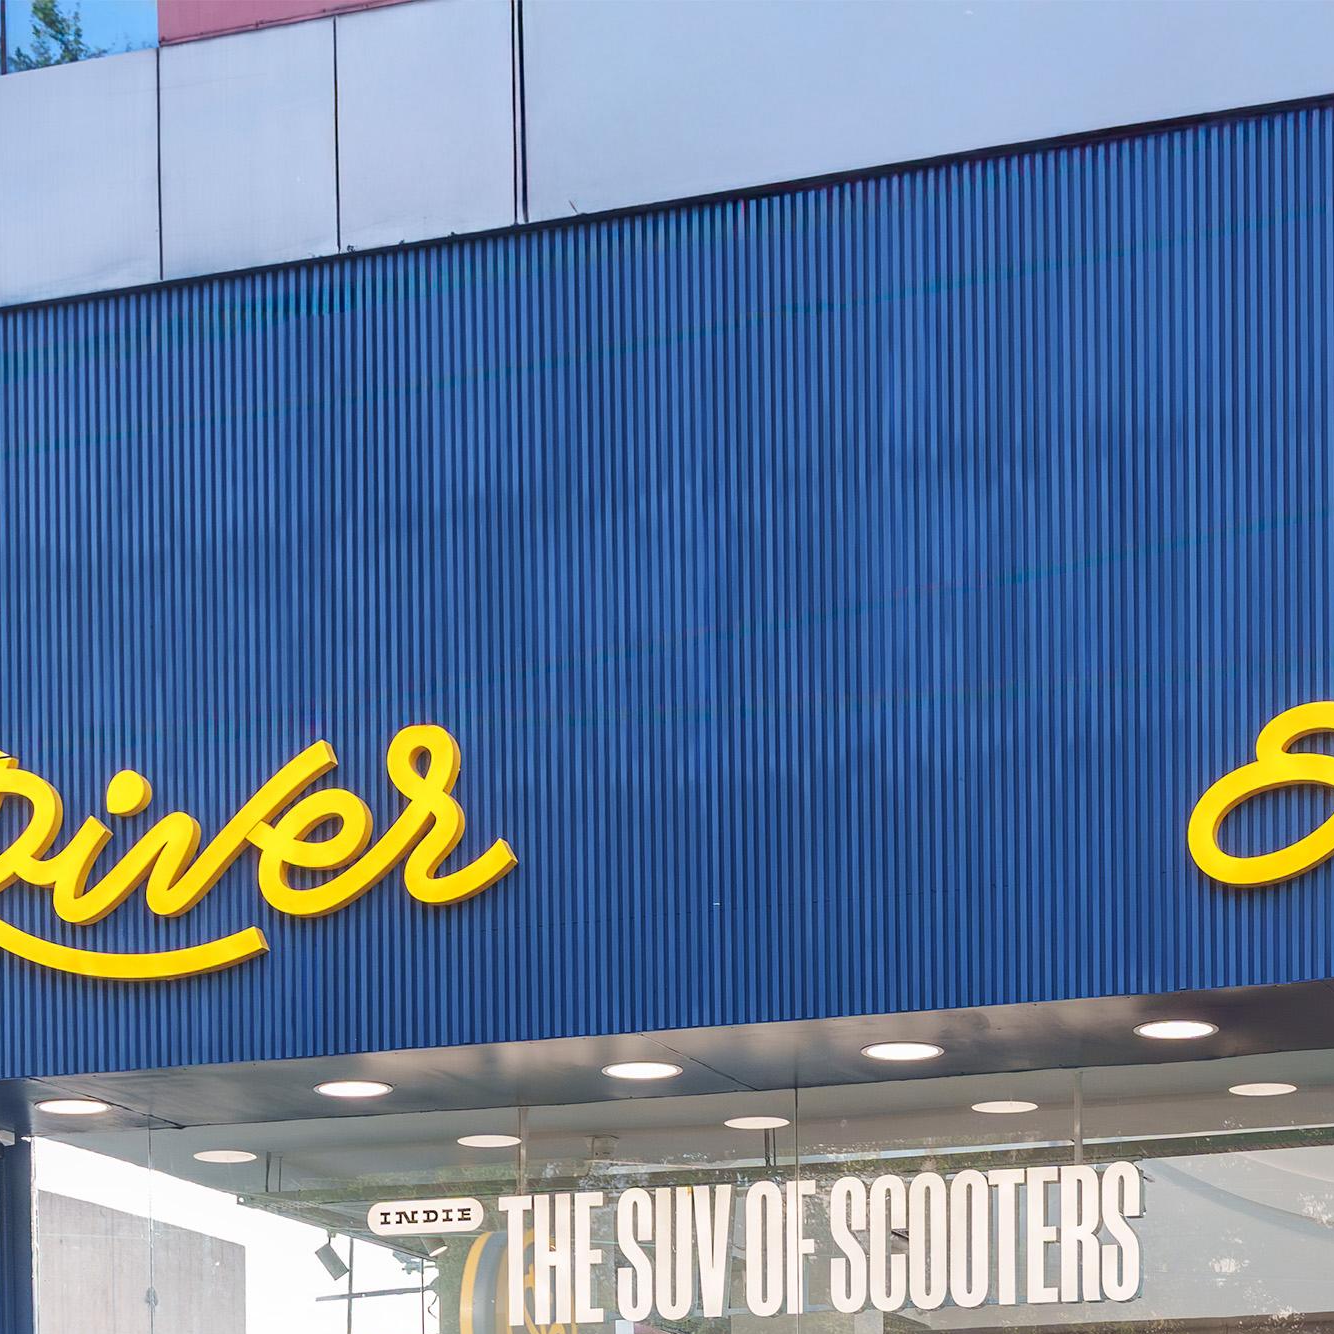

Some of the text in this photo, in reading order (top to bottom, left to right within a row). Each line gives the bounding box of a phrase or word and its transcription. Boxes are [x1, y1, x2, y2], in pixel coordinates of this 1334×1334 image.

[379, 1207, 472, 1225] INDIE
[498, 1191, 605, 1326] THE
[617, 1184, 732, 1322] SUV
[746, 1180, 816, 1317] OF
[830, 1160, 1143, 1314] SCOOTERS
